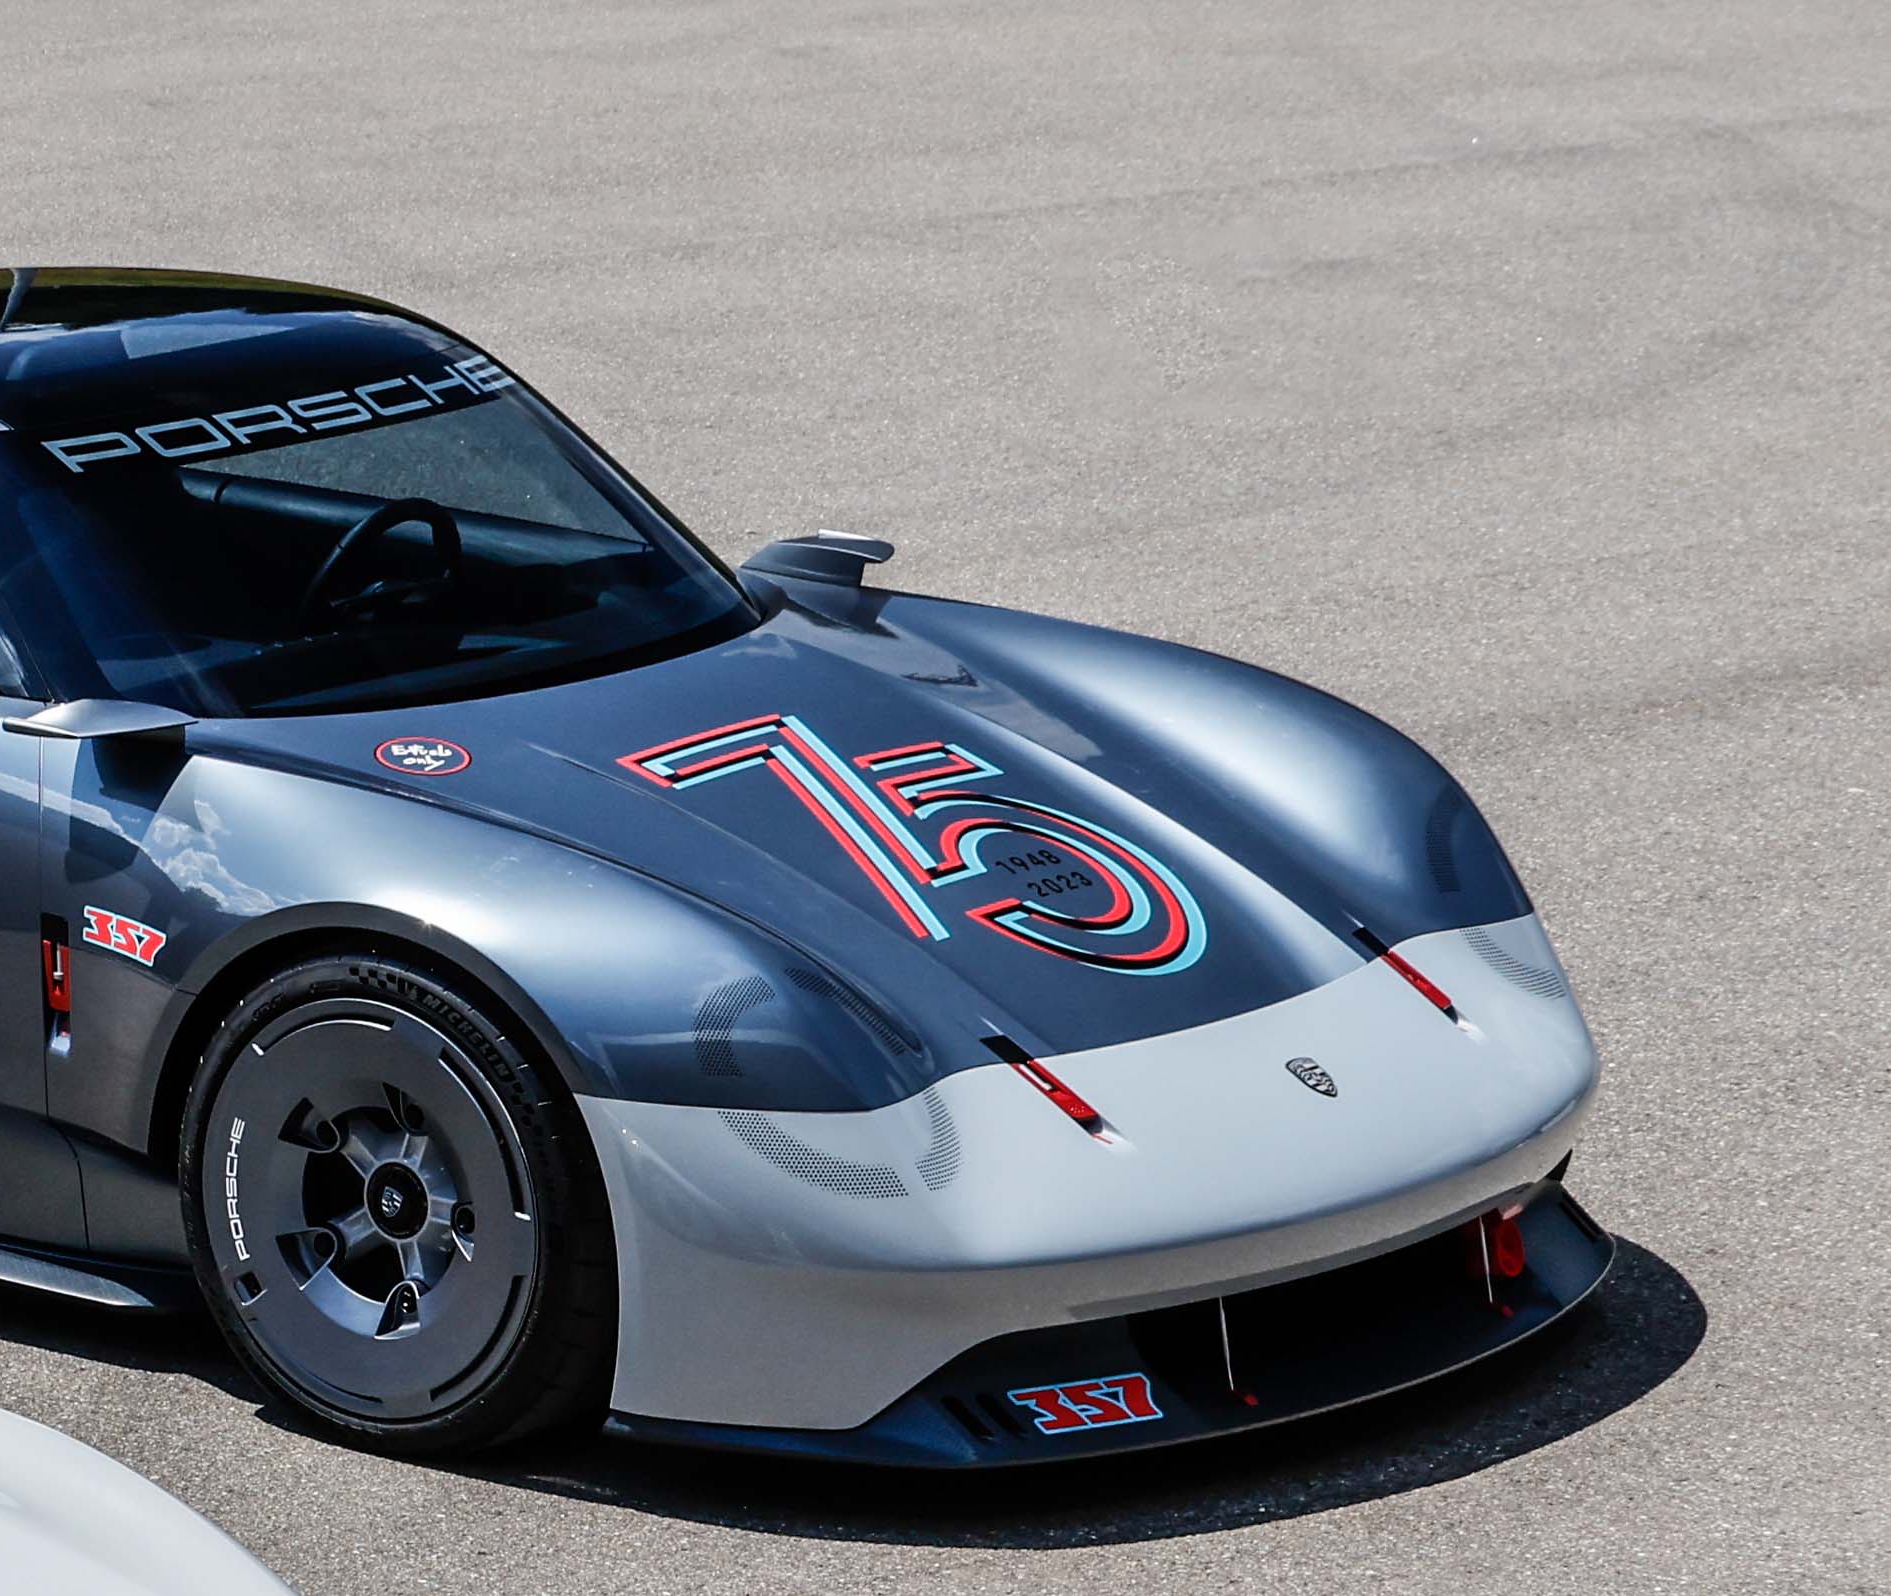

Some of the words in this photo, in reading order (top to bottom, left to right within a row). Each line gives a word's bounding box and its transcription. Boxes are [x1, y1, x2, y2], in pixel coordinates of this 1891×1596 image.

[41, 355, 518, 473] PORSCHE
[617, 714, 1208, 977] 75
[995, 850, 1061, 874] 1948
[1027, 871, 1093, 897] 2023
[83, 905, 167, 967] 357
[423, 994, 510, 1077] MICHELIN
[225, 1116, 251, 1261] PORSCHE
[1007, 1372, 1164, 1435] 357
